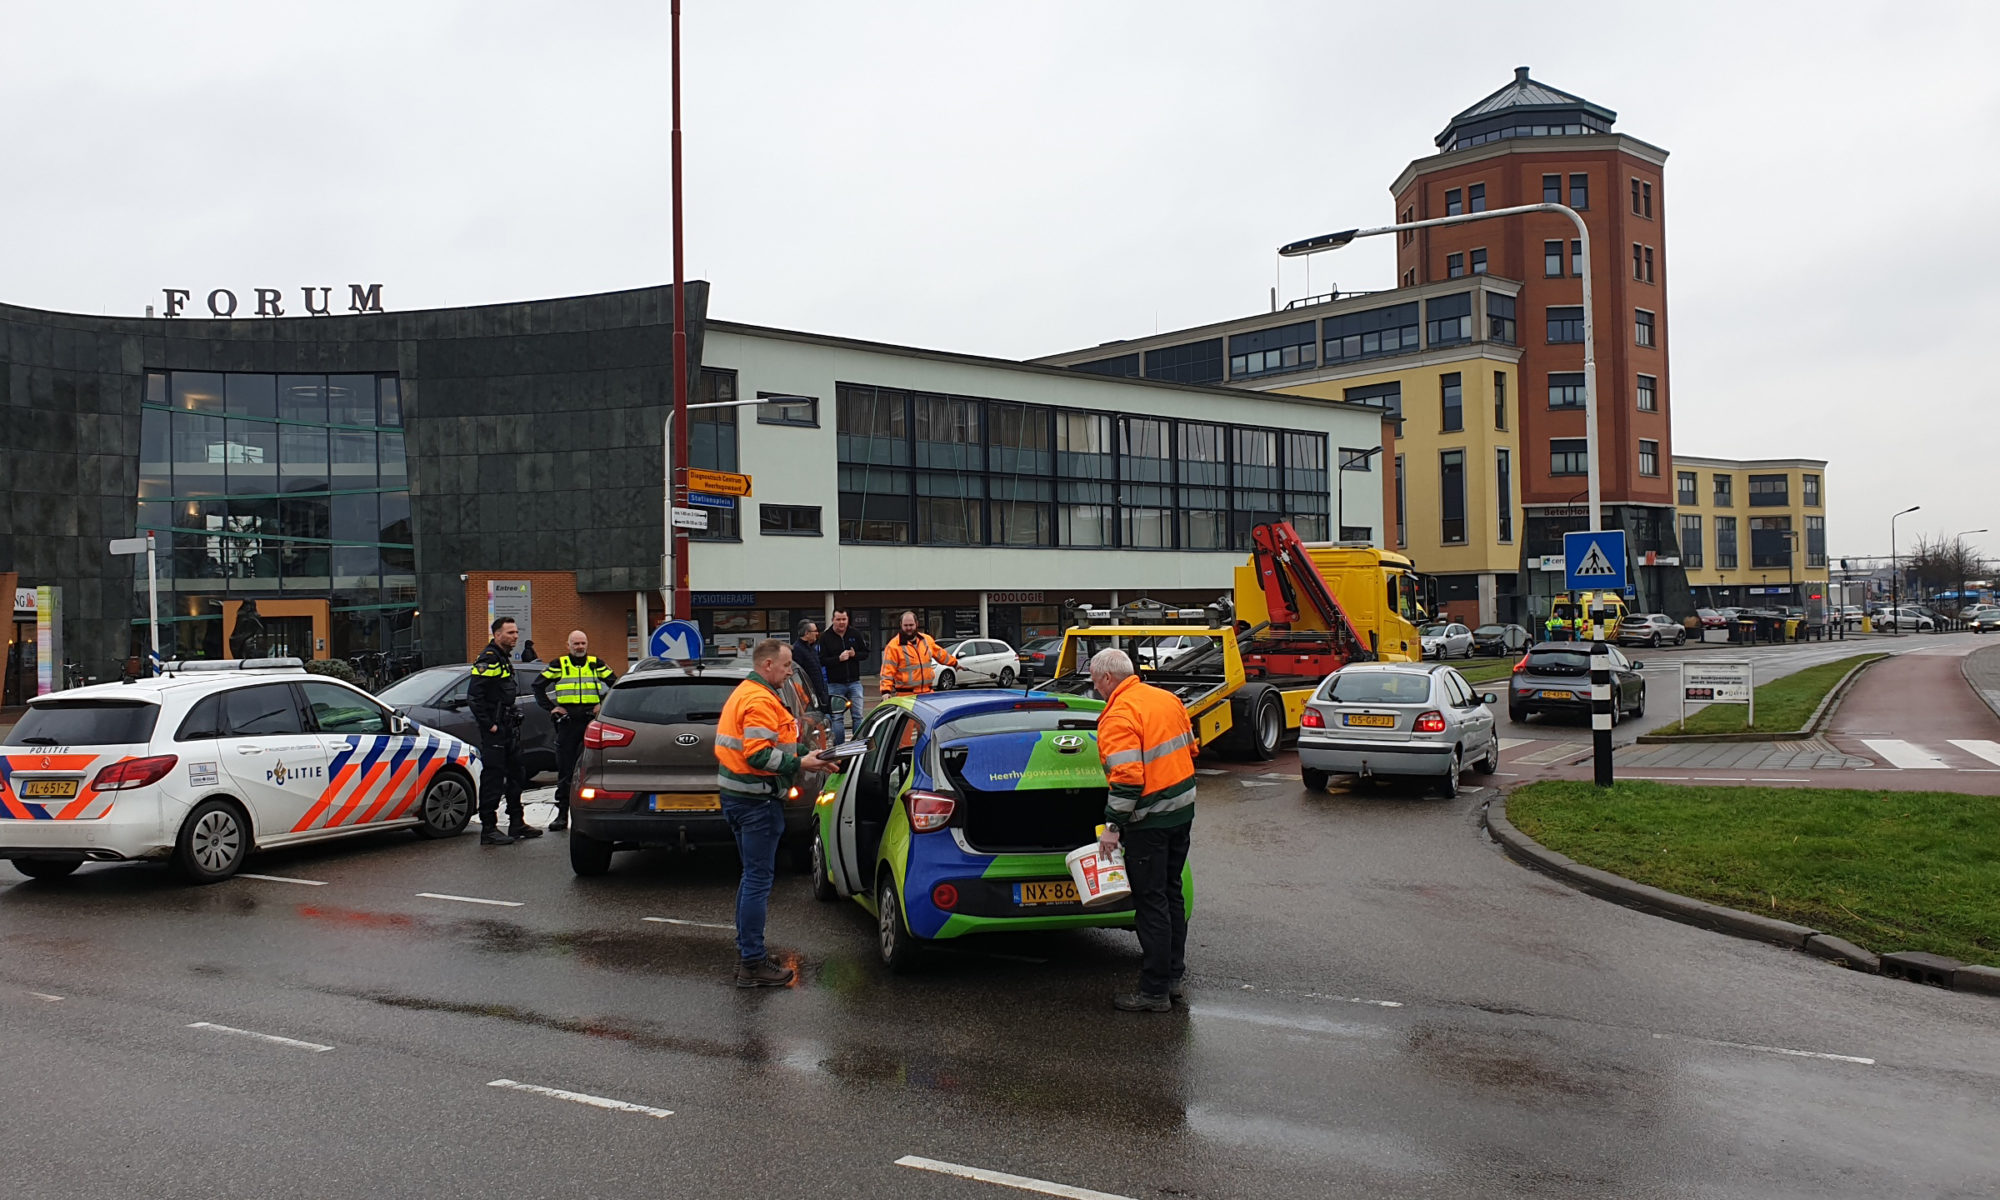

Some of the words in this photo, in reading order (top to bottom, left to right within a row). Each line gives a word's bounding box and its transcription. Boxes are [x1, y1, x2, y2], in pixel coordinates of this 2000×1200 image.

[162, 284, 384, 316] FORUM
[690, 472, 721, 481] Diagnostisch
[722, 475, 742, 484] Centrum
[704, 482, 742, 491] Heerhugowaard
[691, 494, 731, 505] Stationsplein
[1544, 508, 1568, 516] Beter
[1626, 585, 1633, 594] P
[692, 594, 755, 604] FYSIOTHERAPIE
[987, 593, 1043, 602] PODOLOGIE
[1351, 715, 1390, 726] 05-GR-JJ
[30, 746, 70, 754] POLITIE
[266, 766, 322, 786] POLITIE
[989, 767, 1070, 781] Heerhugowaard
[1075, 767, 1097, 776] Stad
[29, 782, 71, 794] XL-651-Z
[1026, 884, 1080, 900] NX-86
